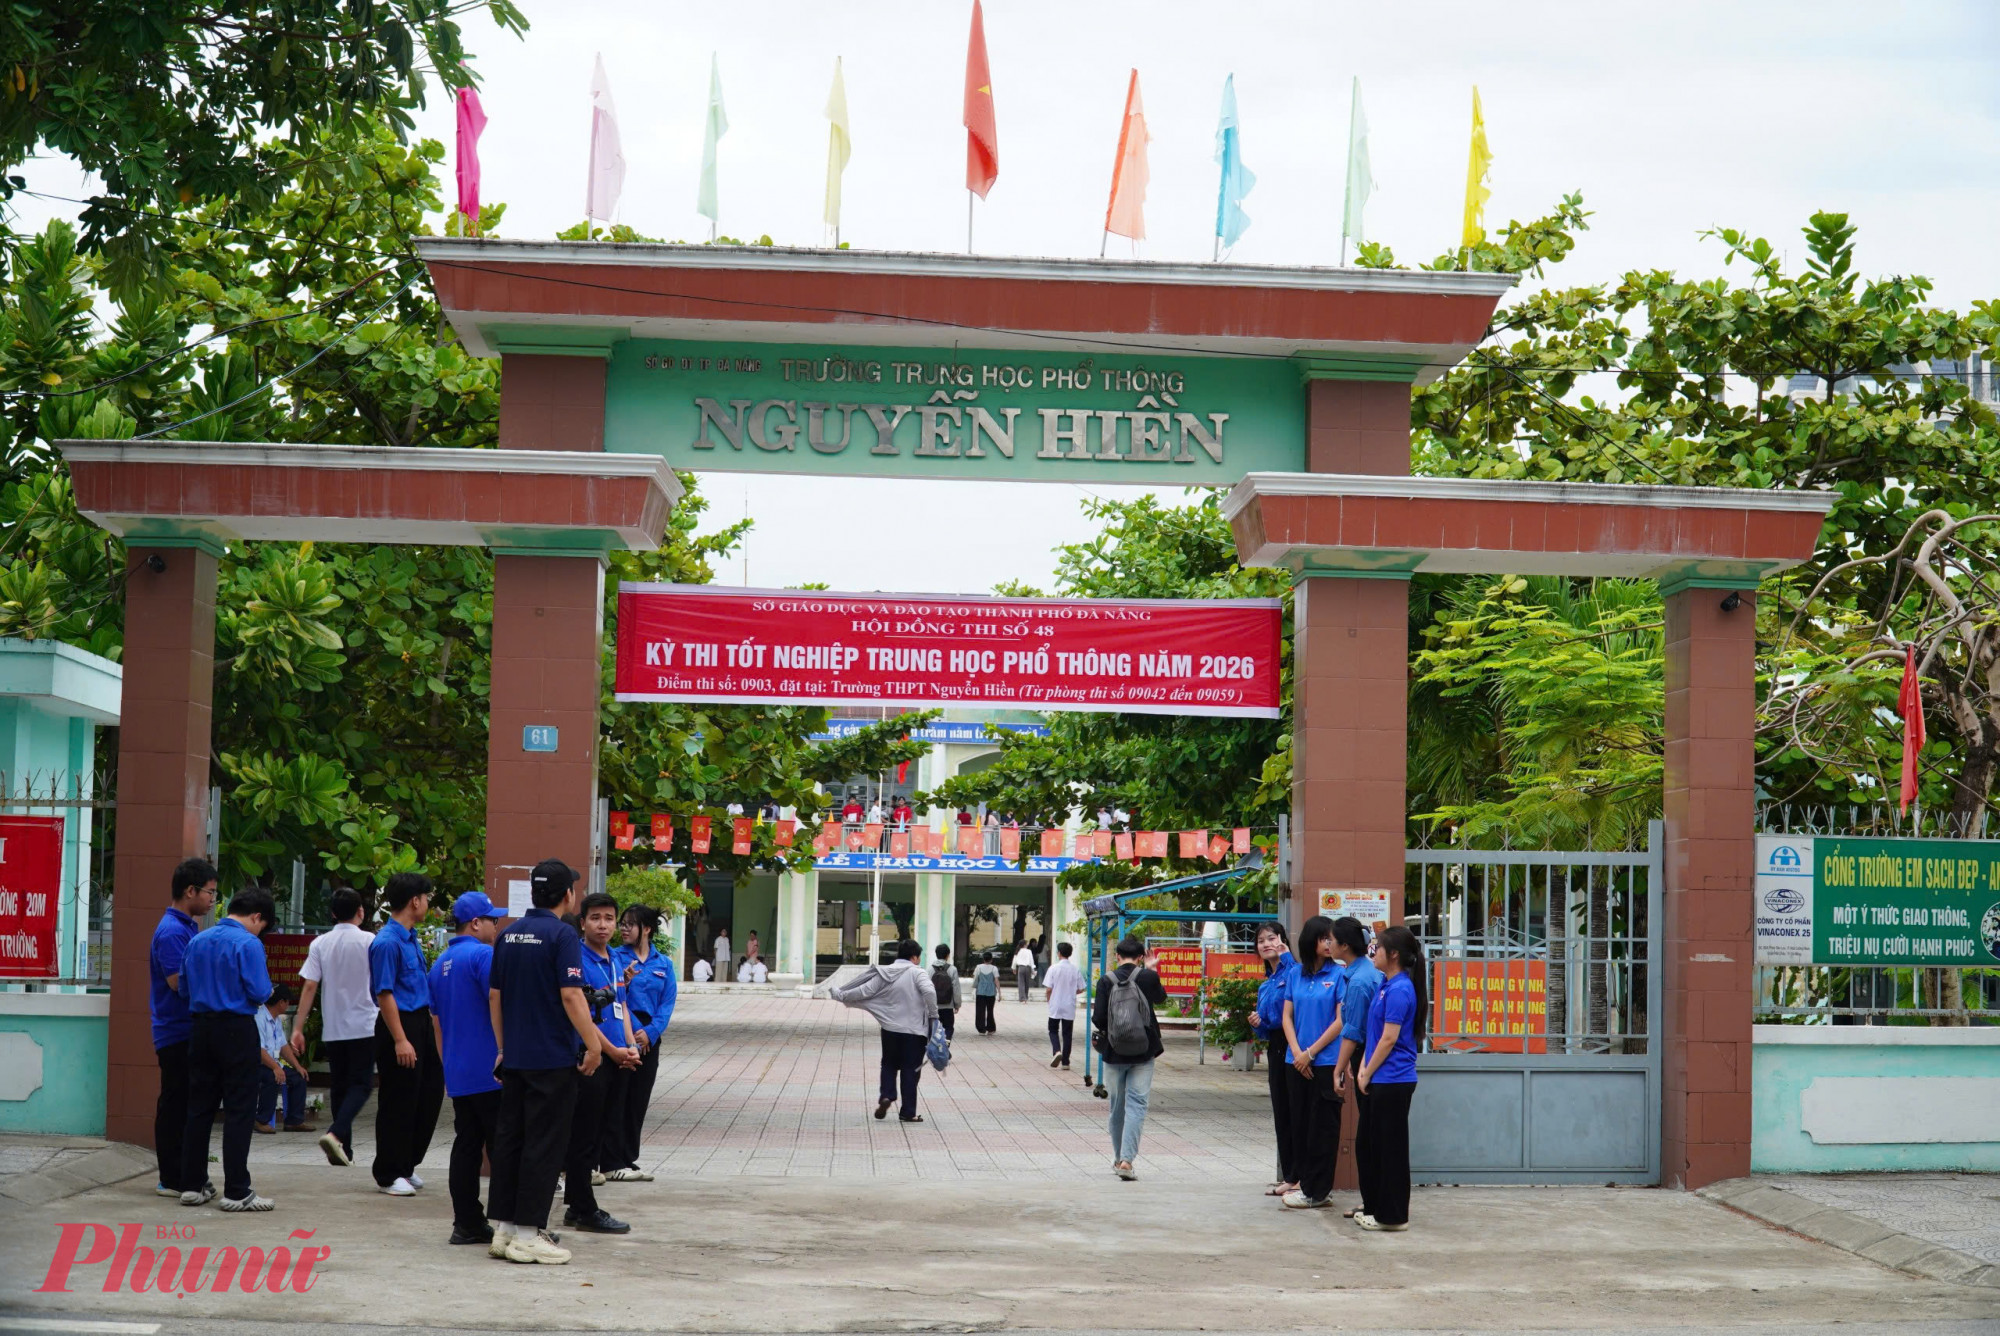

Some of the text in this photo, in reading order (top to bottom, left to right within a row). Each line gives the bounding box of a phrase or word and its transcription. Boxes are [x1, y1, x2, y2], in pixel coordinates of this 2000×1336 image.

[699, 357, 711, 370] TP
[780, 354, 1184, 393] TRƯỜNG TRUNG HỌC PHỔ THÔNG
[692, 390, 1229, 463] NGUYỄN HIỀN
[753, 600, 1151, 621] SỞ GIÁO DỤC VÀ ĐÀO TẠO THÀNH PHỐ ĐÀ NẴNG
[852, 617, 1054, 637] HỘI ĐỒNG THI SỐ 48
[646, 637, 1255, 679] KỲ THI TỐT NGHIỆP TRUNG HỌC PHỔ THÔNG NĂM 2026
[657, 673, 692, 689] Điểm
[696, 677, 714, 690] thi
[718, 675, 737, 691] số:
[741, 678, 776, 692] 0903,
[779, 680, 801, 695] đặt
[805, 680, 826, 695] tại:
[831, 680, 881, 697] Trường
[885, 682, 926, 695] THPT
[930, 680, 981, 698] Nguyễn
[984, 682, 1015, 697] Hiền
[1019, 683, 1044, 699] (Từ
[1045, 686, 1086, 701] phòng
[1090, 687, 1108, 699] thi
[1110, 684, 1125, 699] số
[1129, 688, 1166, 700] 09042
[1169, 686, 1193, 700] đến
[1197, 689, 1235, 701] 09059
[532, 728, 548, 745] 61
[920, 726, 946, 738] trăm
[950, 727, 972, 738] năm
[937, 859, 996, 871] HỌC
[1824, 844, 1855, 887] CỔNG
[1858, 849, 1902, 888] TRƯỜNG
[1905, 857, 1922, 888] EM
[1926, 858, 1954, 896] SẠCH
[1957, 859, 1979, 896] ĐẸP
[26, 892, 46, 917] 20M
[1757, 917, 1774, 925] CÔNG
[1833, 903, 1970, 929] MỘT Ý THỨC GIAO THÔNG,
[1757, 928, 1811, 937] VINACONEX 25
[0, 929, 38, 959] TRƯỜNG
[1829, 934, 1975, 960] TRIỆU NỤ CƯỜI HẠNH PHÚC
[1518, 979, 1546, 994] VNH,
[1517, 1000, 1546, 1015] HNG
